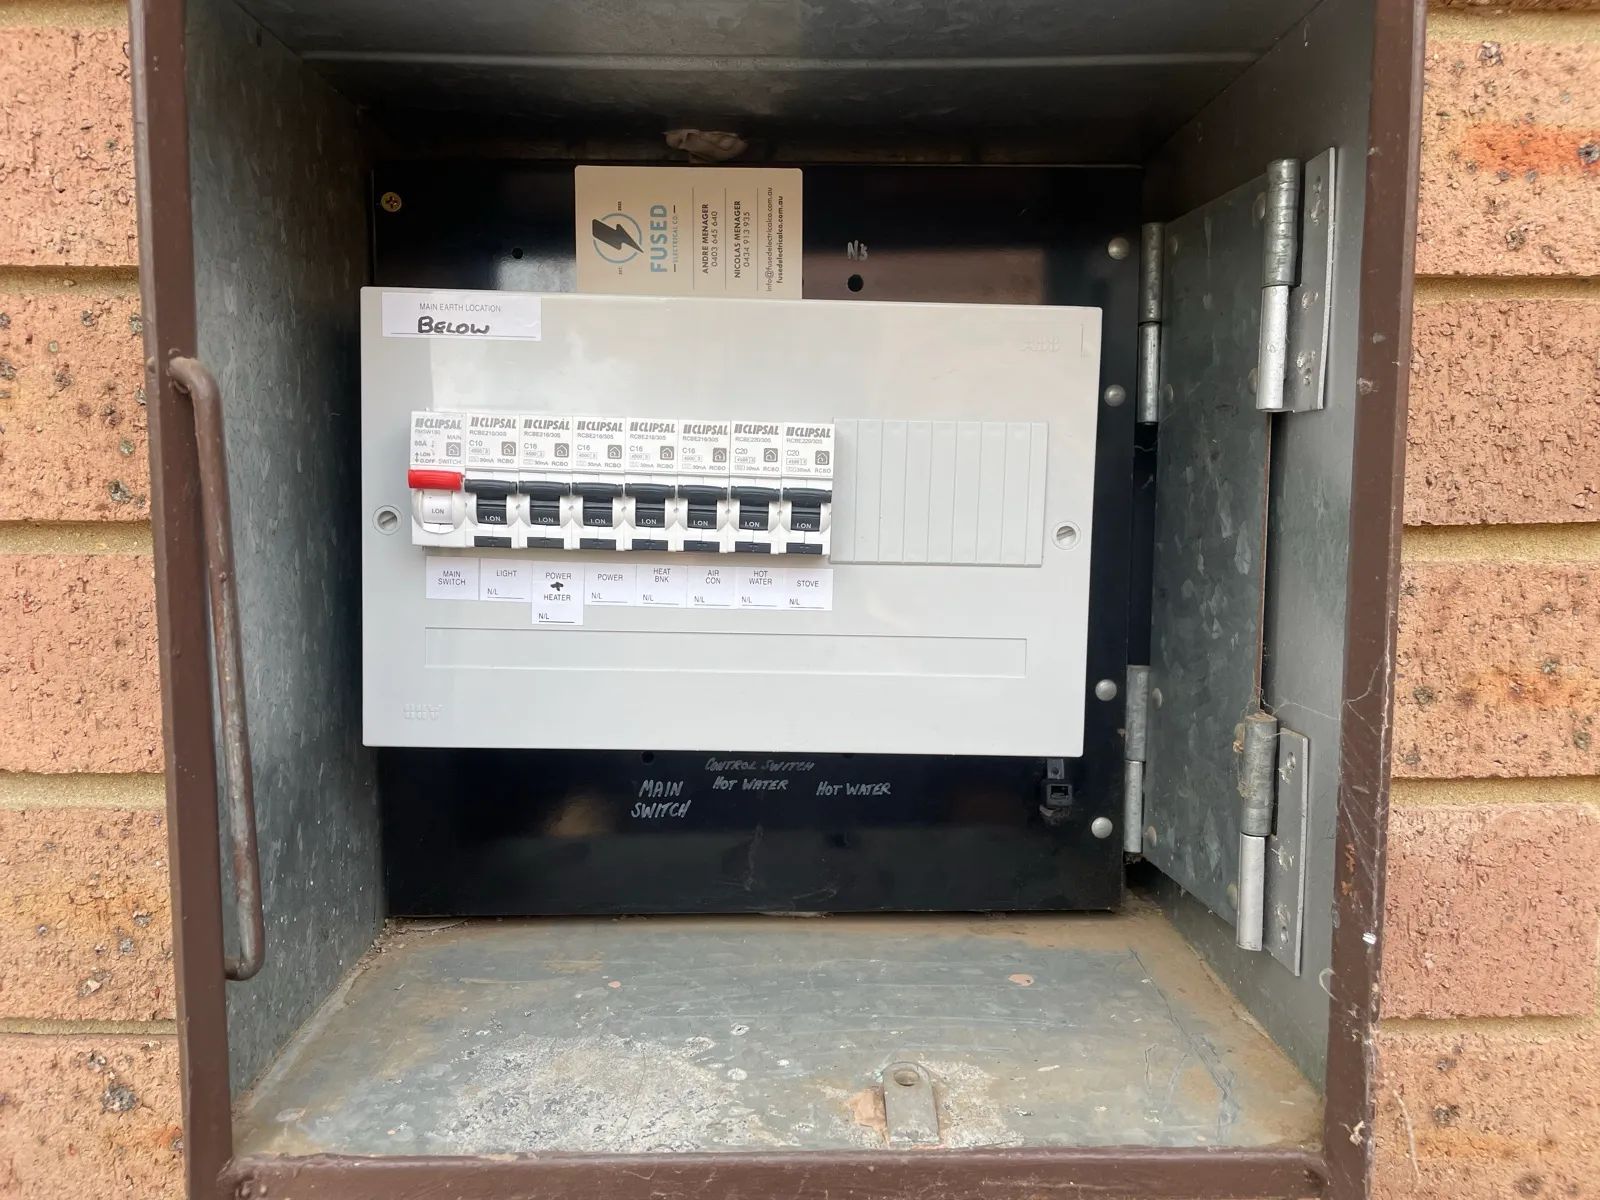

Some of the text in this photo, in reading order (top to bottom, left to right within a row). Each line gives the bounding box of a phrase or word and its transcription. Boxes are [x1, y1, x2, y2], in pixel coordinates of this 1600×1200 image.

[650, 204, 668, 272] FUSED
[764, 187, 774, 292] info@fusedelectricalco.com.au
[440, 304, 464, 312] EARTH
[424, 418, 462, 429] CLIPSAL
[480, 417, 516, 429] CLIPSAL
[533, 420, 570, 430] CLIPSAL
[586, 421, 623, 432] CLIPSAL
[639, 422, 675, 433] CLIPSAL
[692, 425, 728, 435] CLIPSAL
[743, 424, 779, 435] CLIPSAL
[795, 427, 831, 438] CLIPSAL
[705, 757, 814, 772] CONTROL SWITCH
[638, 779, 684, 797] MAIN
[713, 776, 788, 791] HOT WATER
[816, 781, 891, 796] HOT WATER
[631, 800, 691, 819] SWITCH
